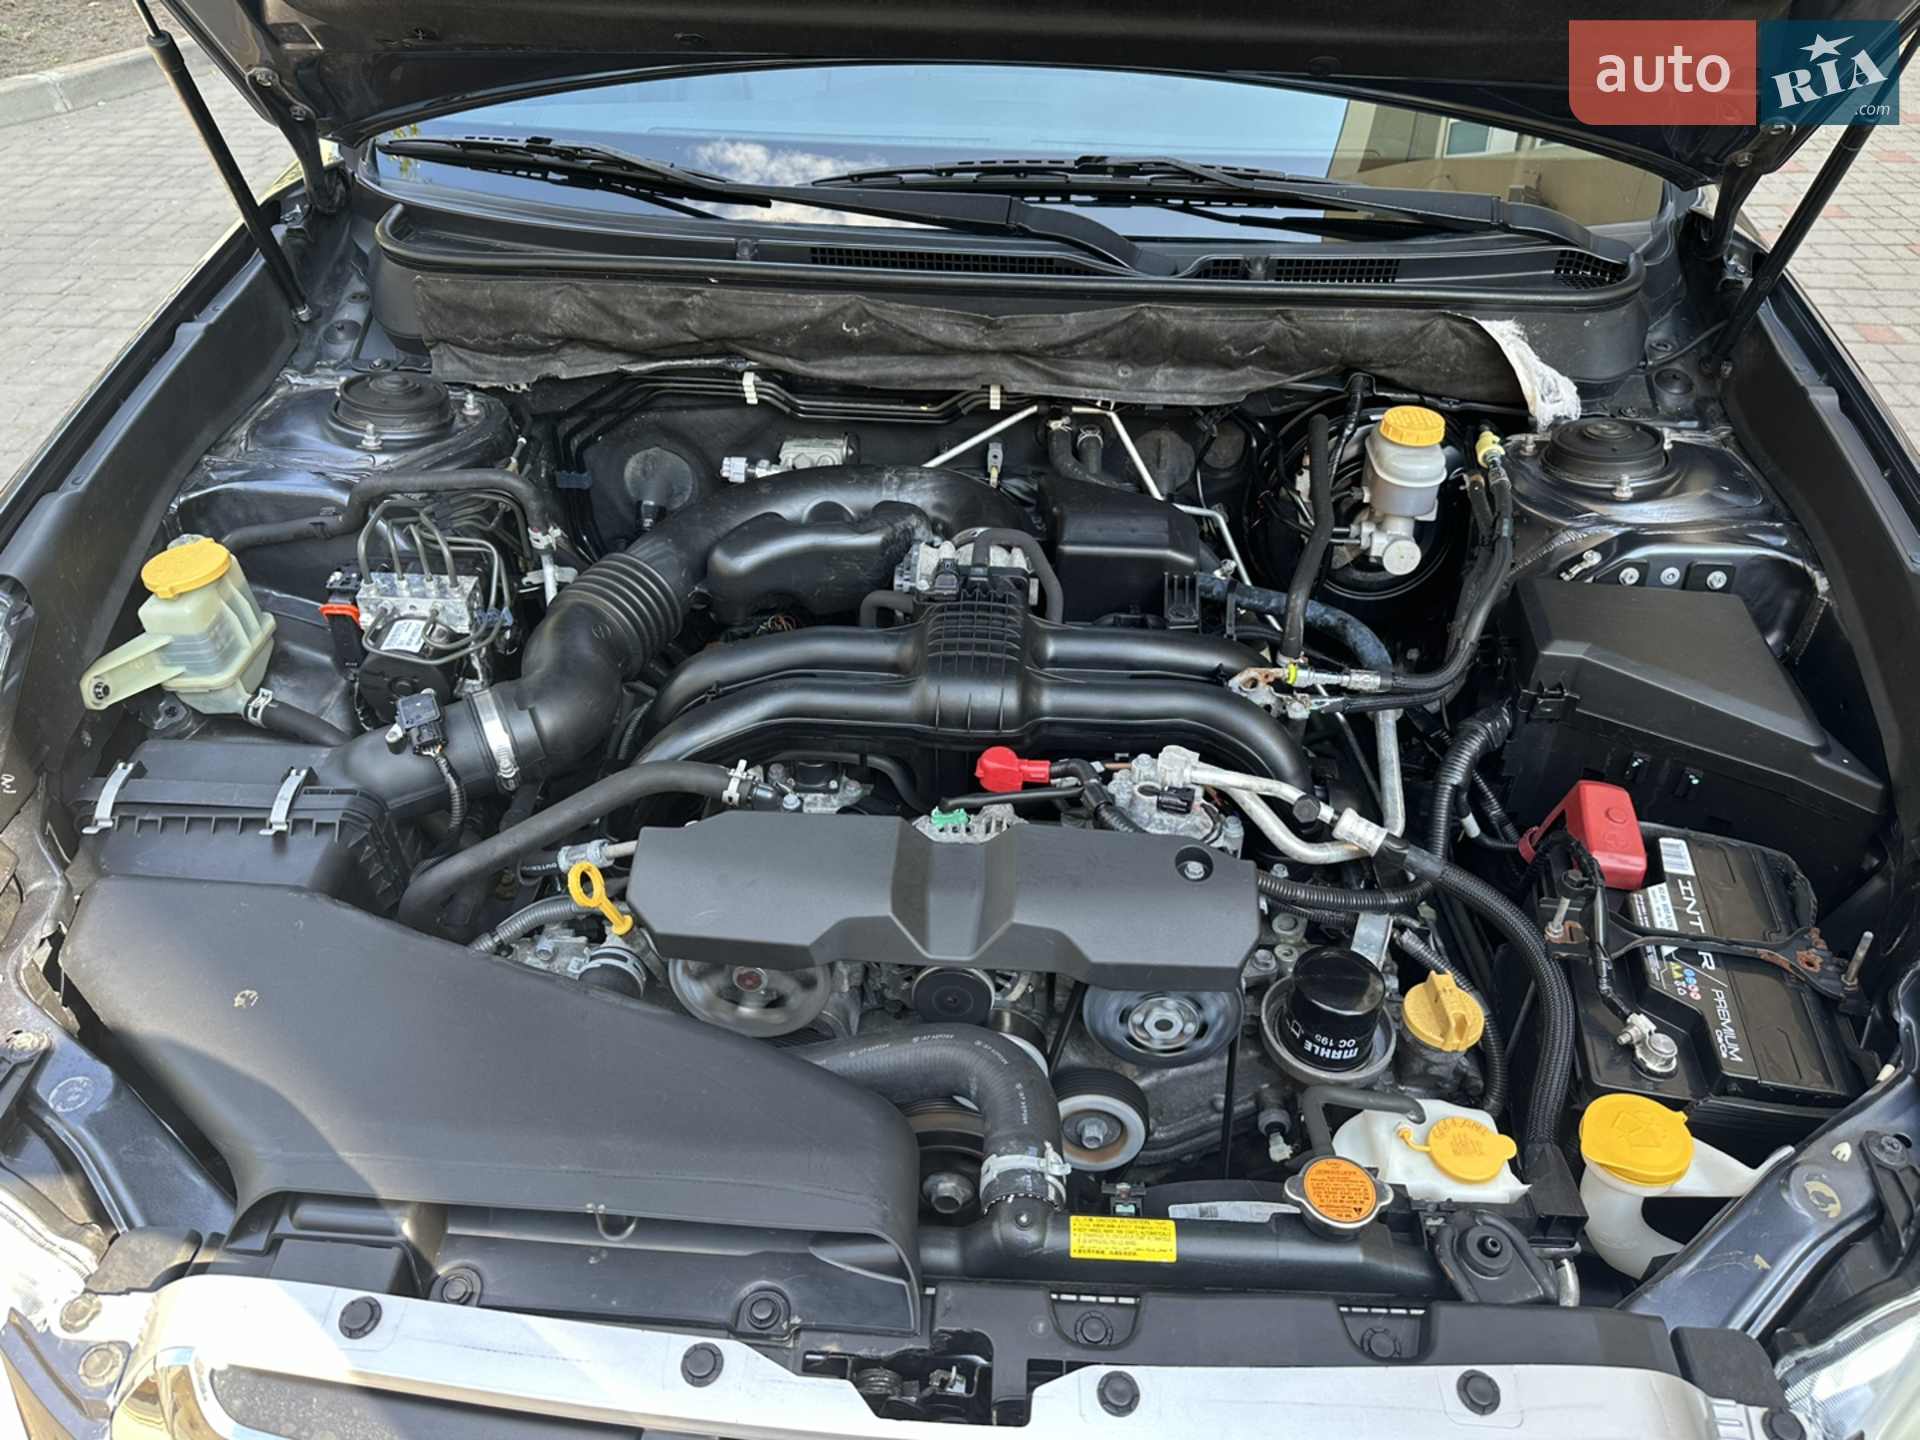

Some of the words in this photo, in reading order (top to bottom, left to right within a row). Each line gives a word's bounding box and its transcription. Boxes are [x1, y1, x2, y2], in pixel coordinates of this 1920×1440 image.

[1676, 879, 1716, 972] INTR
[1711, 989, 1745, 1063] PREMIUM
[1303, 1039, 1360, 1061] MAHLE
[1314, 1033, 1336, 1048] 195
[1337, 1038, 1356, 1049] OC
